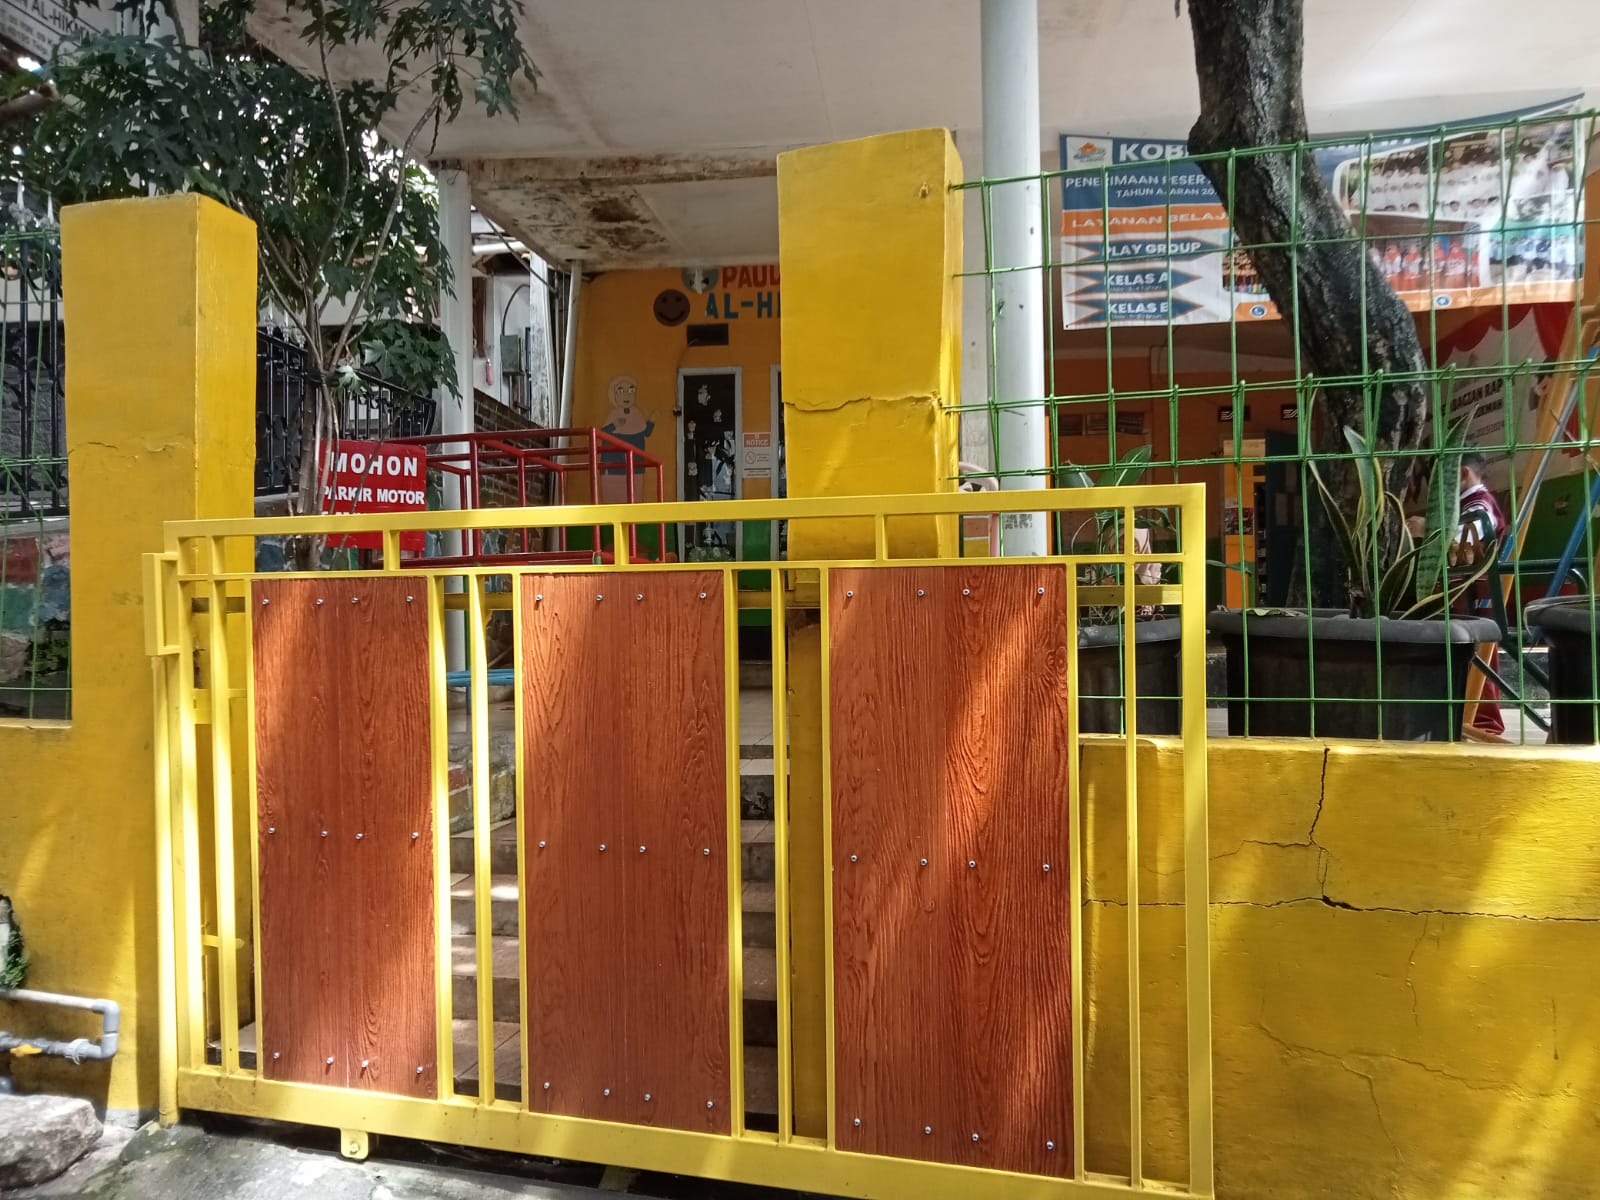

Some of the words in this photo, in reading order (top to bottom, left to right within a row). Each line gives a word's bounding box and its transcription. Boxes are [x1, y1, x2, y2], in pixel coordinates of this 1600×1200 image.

[1119, 144, 1189, 161] KOB
[1065, 175, 1159, 188] PENEIMAAN
[1116, 187, 1154, 198] TAHUN
[1168, 211, 1229, 222] BELAJ
[1145, 242, 1201, 255] GROUP
[1104, 273, 1155, 286] KELAS
[1158, 271, 1169, 283] A
[1108, 302, 1157, 314] KELAS
[330, 451, 418, 477] MOHON
[377, 488, 425, 505] MOTOR
